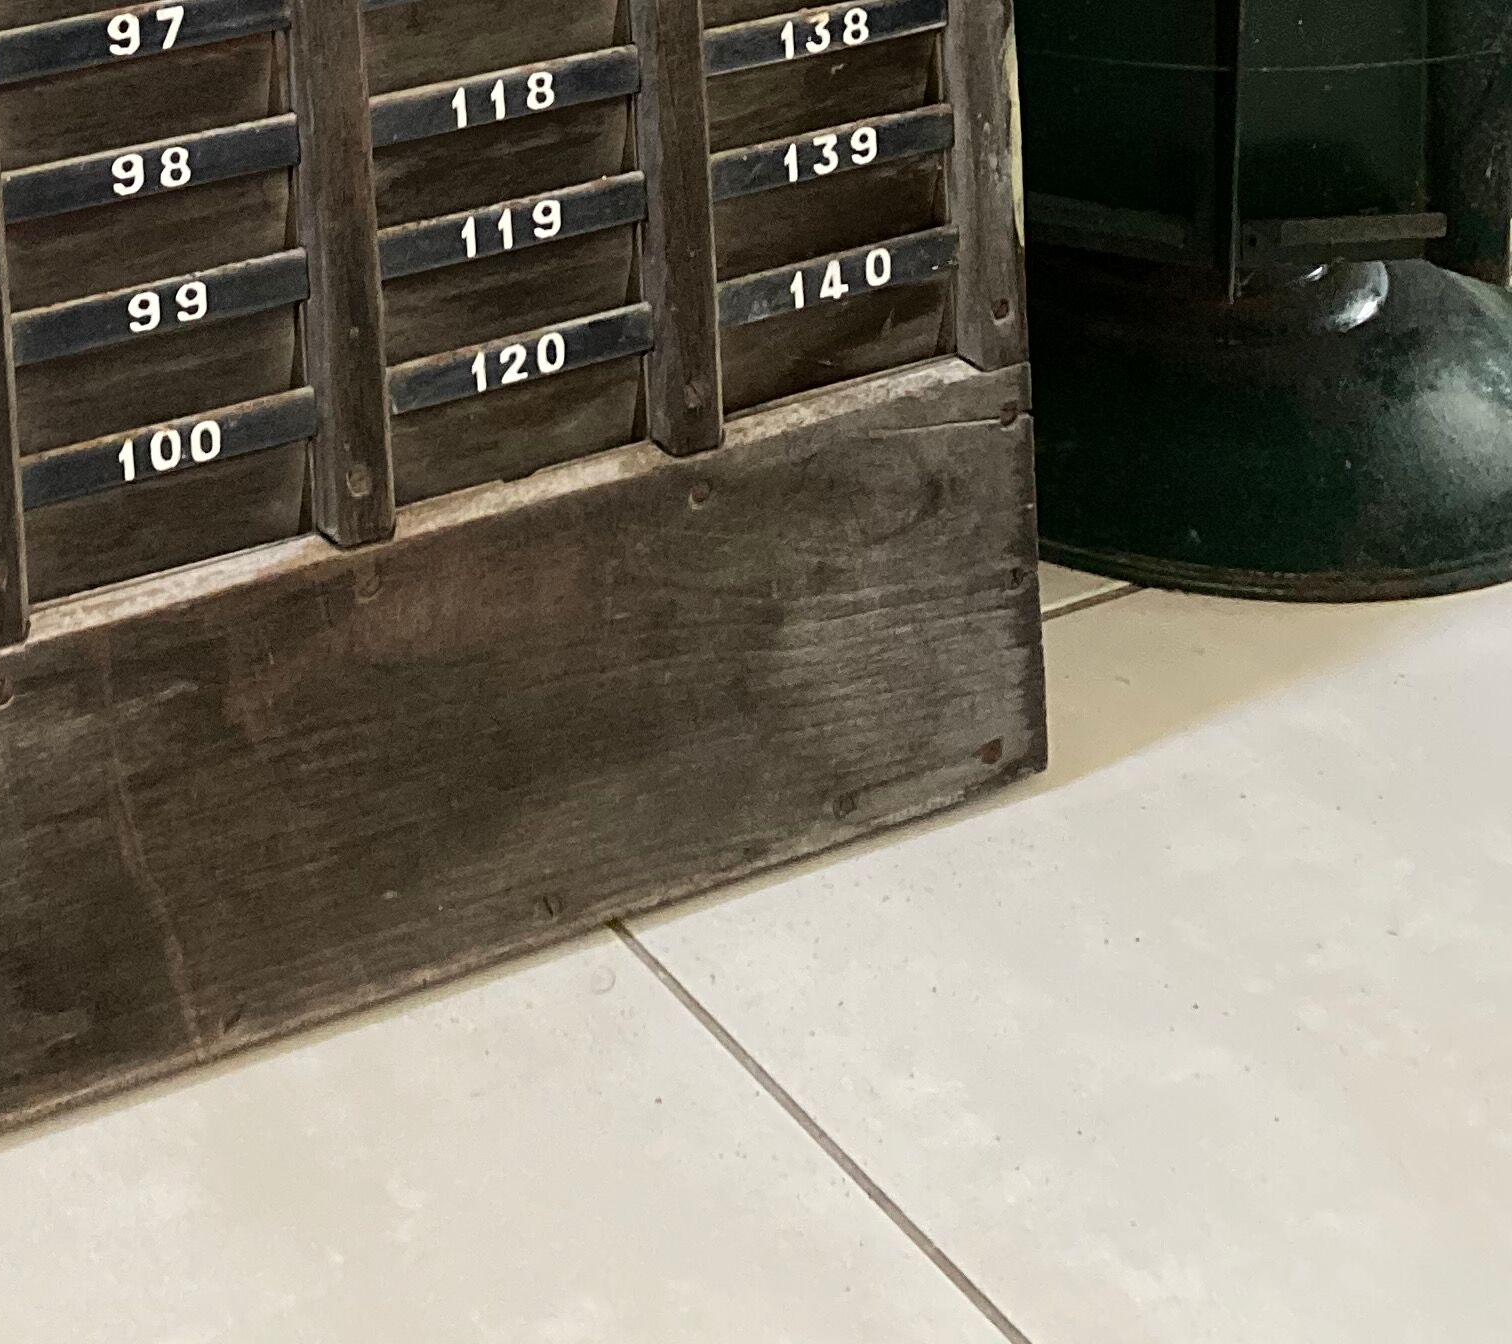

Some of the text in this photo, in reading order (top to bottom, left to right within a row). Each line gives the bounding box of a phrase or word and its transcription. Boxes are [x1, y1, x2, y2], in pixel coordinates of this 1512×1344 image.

[108, 6, 184, 55] 97
[452, 72, 554, 128] 118
[112, 147, 191, 195] 98
[784, 127, 877, 182] 139
[791, 248, 890, 308] 140
[128, 281, 207, 332] 99
[472, 332, 564, 392] 120
